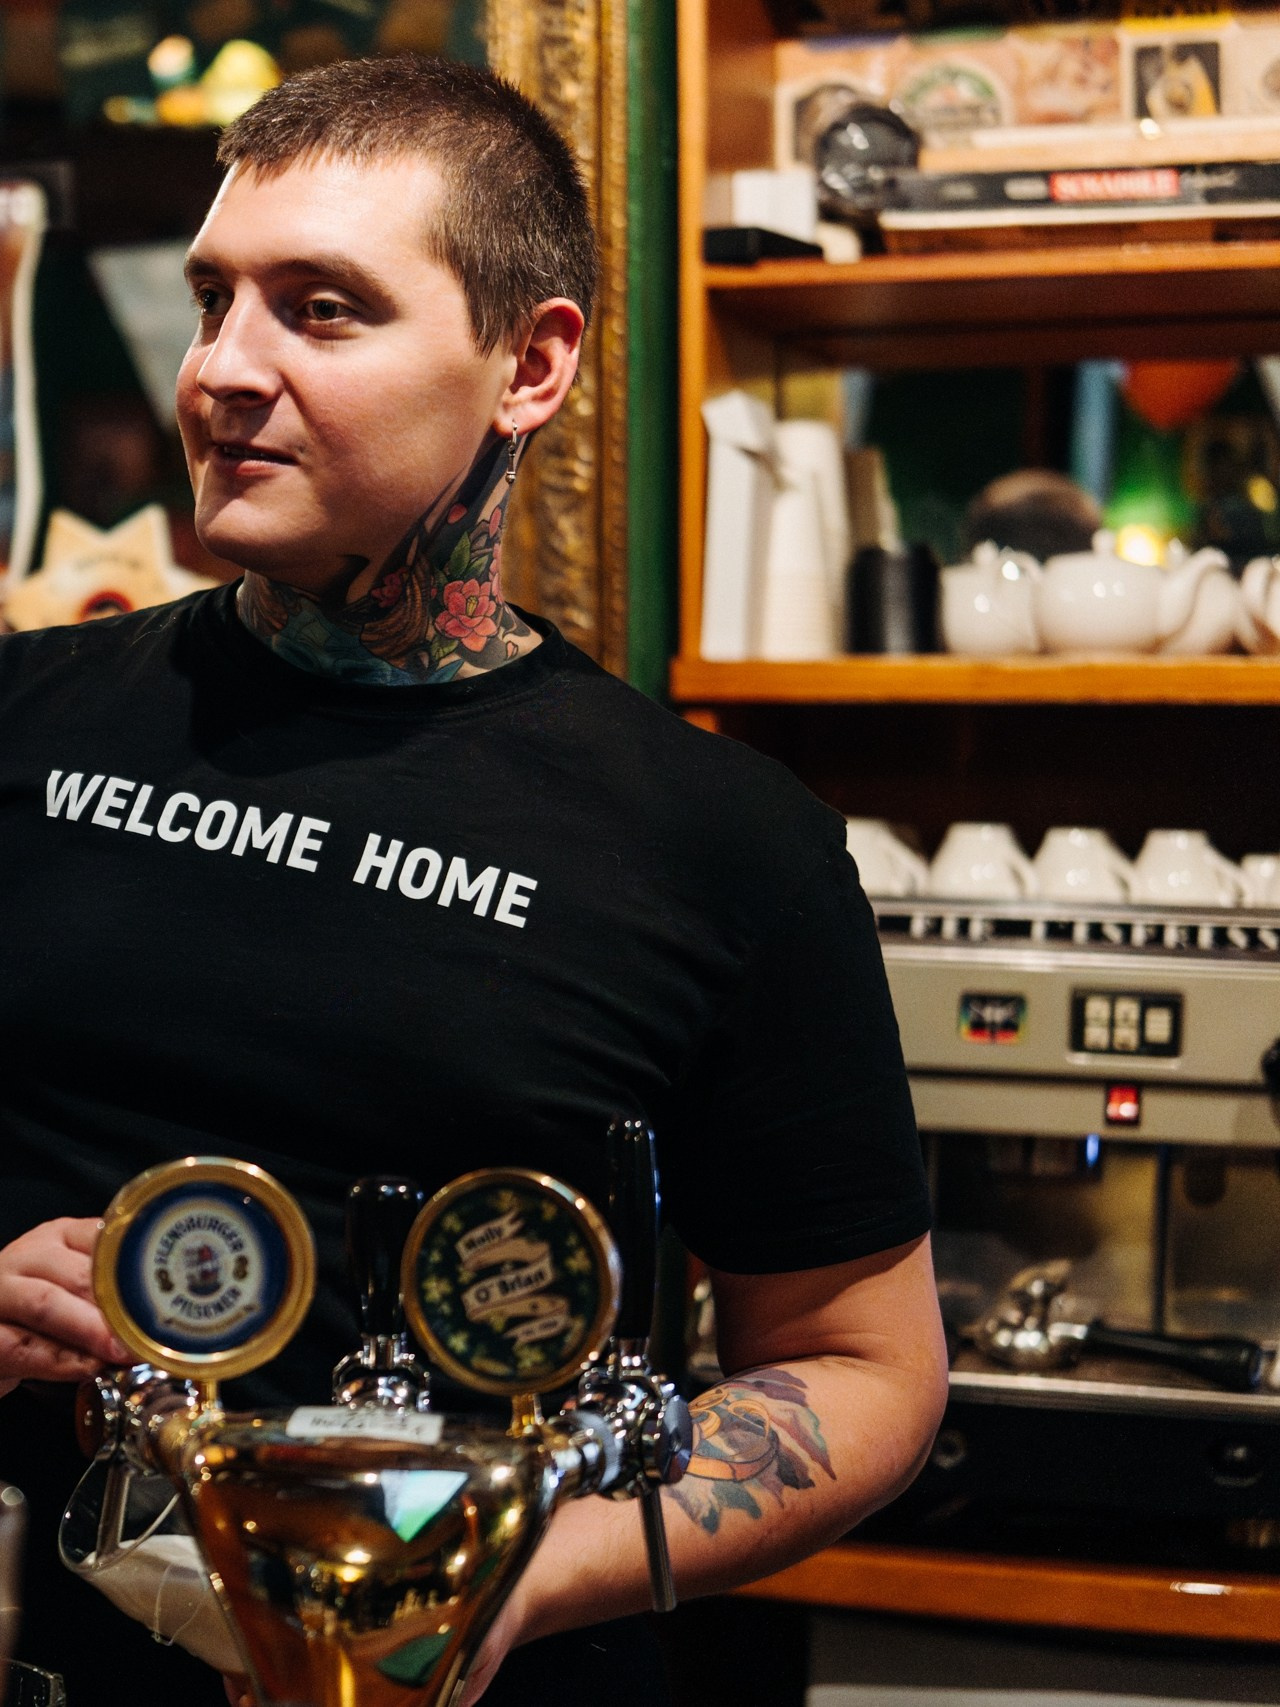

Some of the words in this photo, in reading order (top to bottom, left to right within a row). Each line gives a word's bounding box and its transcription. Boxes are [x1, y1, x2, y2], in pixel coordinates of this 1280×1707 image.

[46, 770, 331, 873] WELCOME
[352, 832, 538, 929] HOME
[171, 1285, 242, 1320] PILSENER
